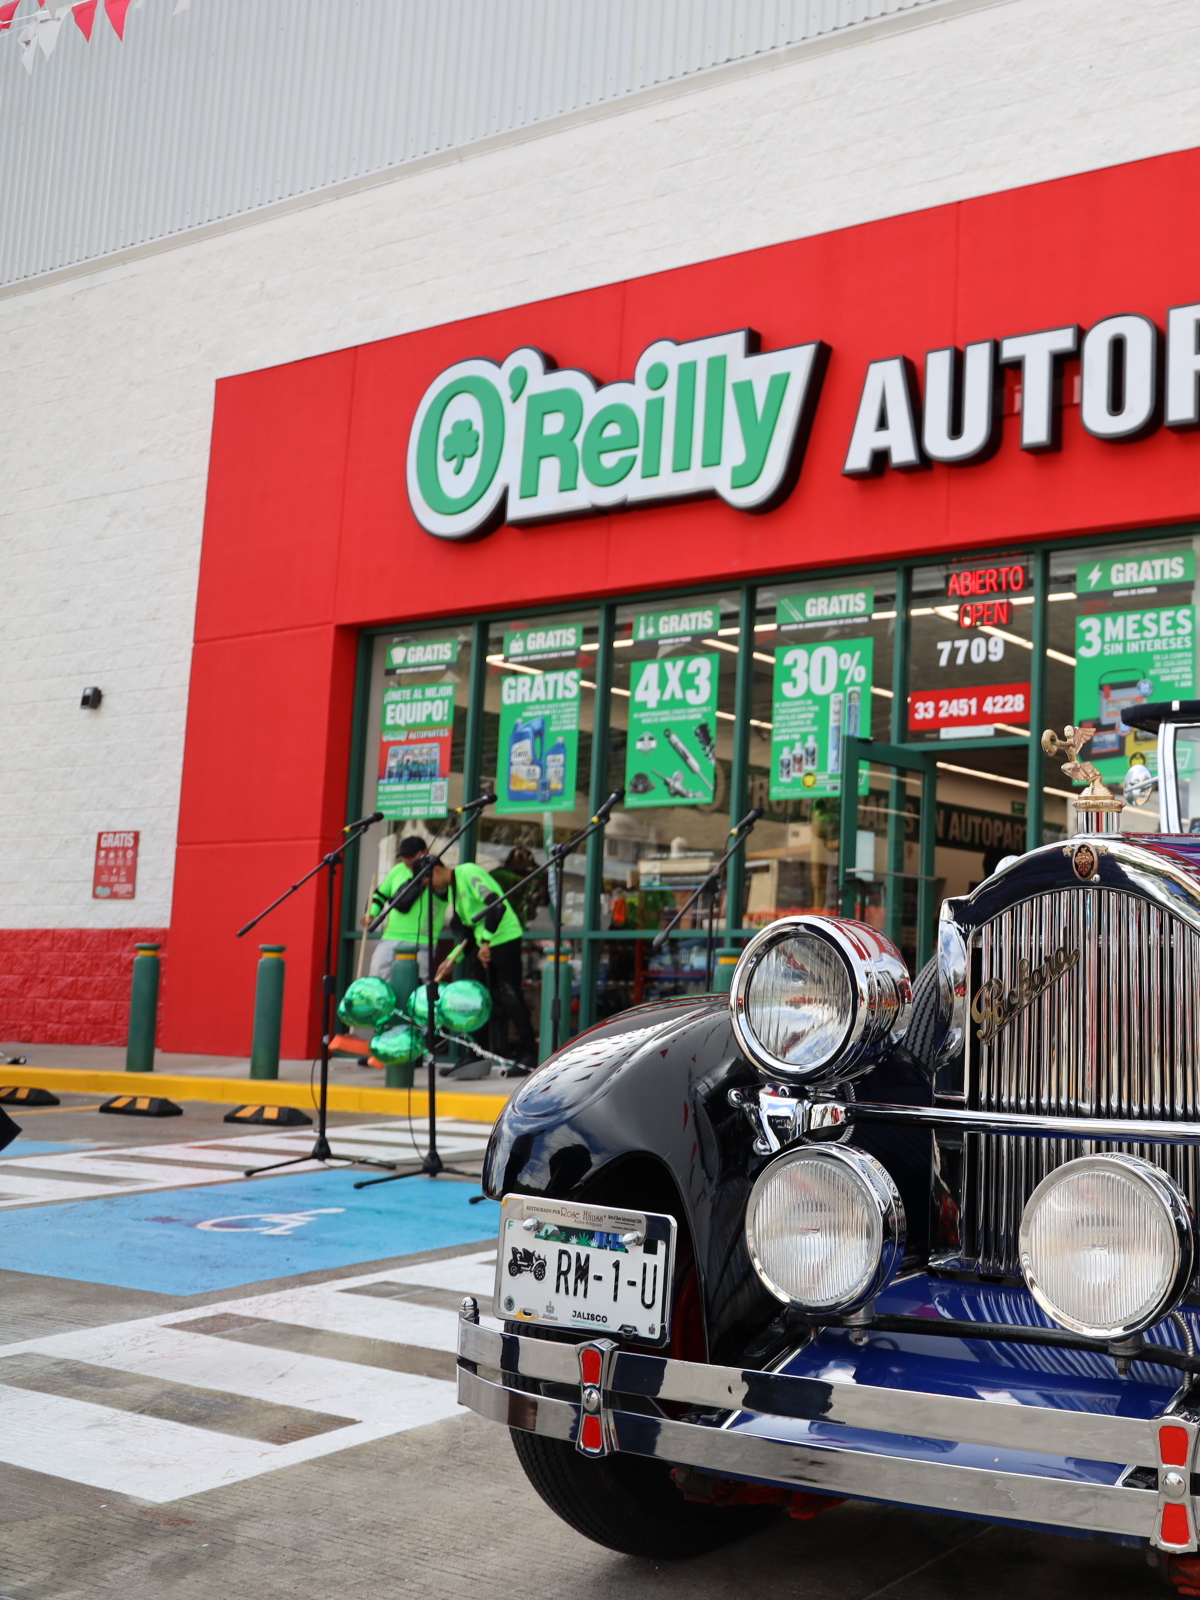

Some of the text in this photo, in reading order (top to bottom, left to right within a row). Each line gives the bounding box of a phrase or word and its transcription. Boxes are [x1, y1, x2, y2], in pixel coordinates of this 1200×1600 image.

[416, 353, 791, 515] O'Reilly
[947, 565, 1025, 597] ABIERTO
[1110, 556, 1185, 585] GRATIS
[805, 592, 866, 618] GRATIS
[959, 602, 1008, 628] OPEN
[658, 610, 713, 635] GRATIS
[1077, 608, 1193, 658] 3 MESES
[526, 628, 576, 651] GRATIS
[937, 636, 1005, 667] 7709
[1103, 636, 1192, 656] SIN INTERESES
[407, 642, 452, 664] GRATIS
[635, 657, 712, 709] 4X3
[781, 645, 866, 698] 30%
[412, 688, 423, 699] AL
[424, 685, 453, 698] MEJOR
[502, 670, 579, 705] GRATIS
[385, 699, 449, 727] EQUIPO!
[914, 693, 1025, 719] 33 2451 4228
[101, 832, 135, 848] GRATIS
[948, 811, 1027, 849] AUTOPAR
[507, 1220, 514, 1230] F
[560, 1206, 580, 1219] Rose
[555, 1248, 658, 1309] RM-1-U
[571, 1310, 608, 1323] JALISCO
